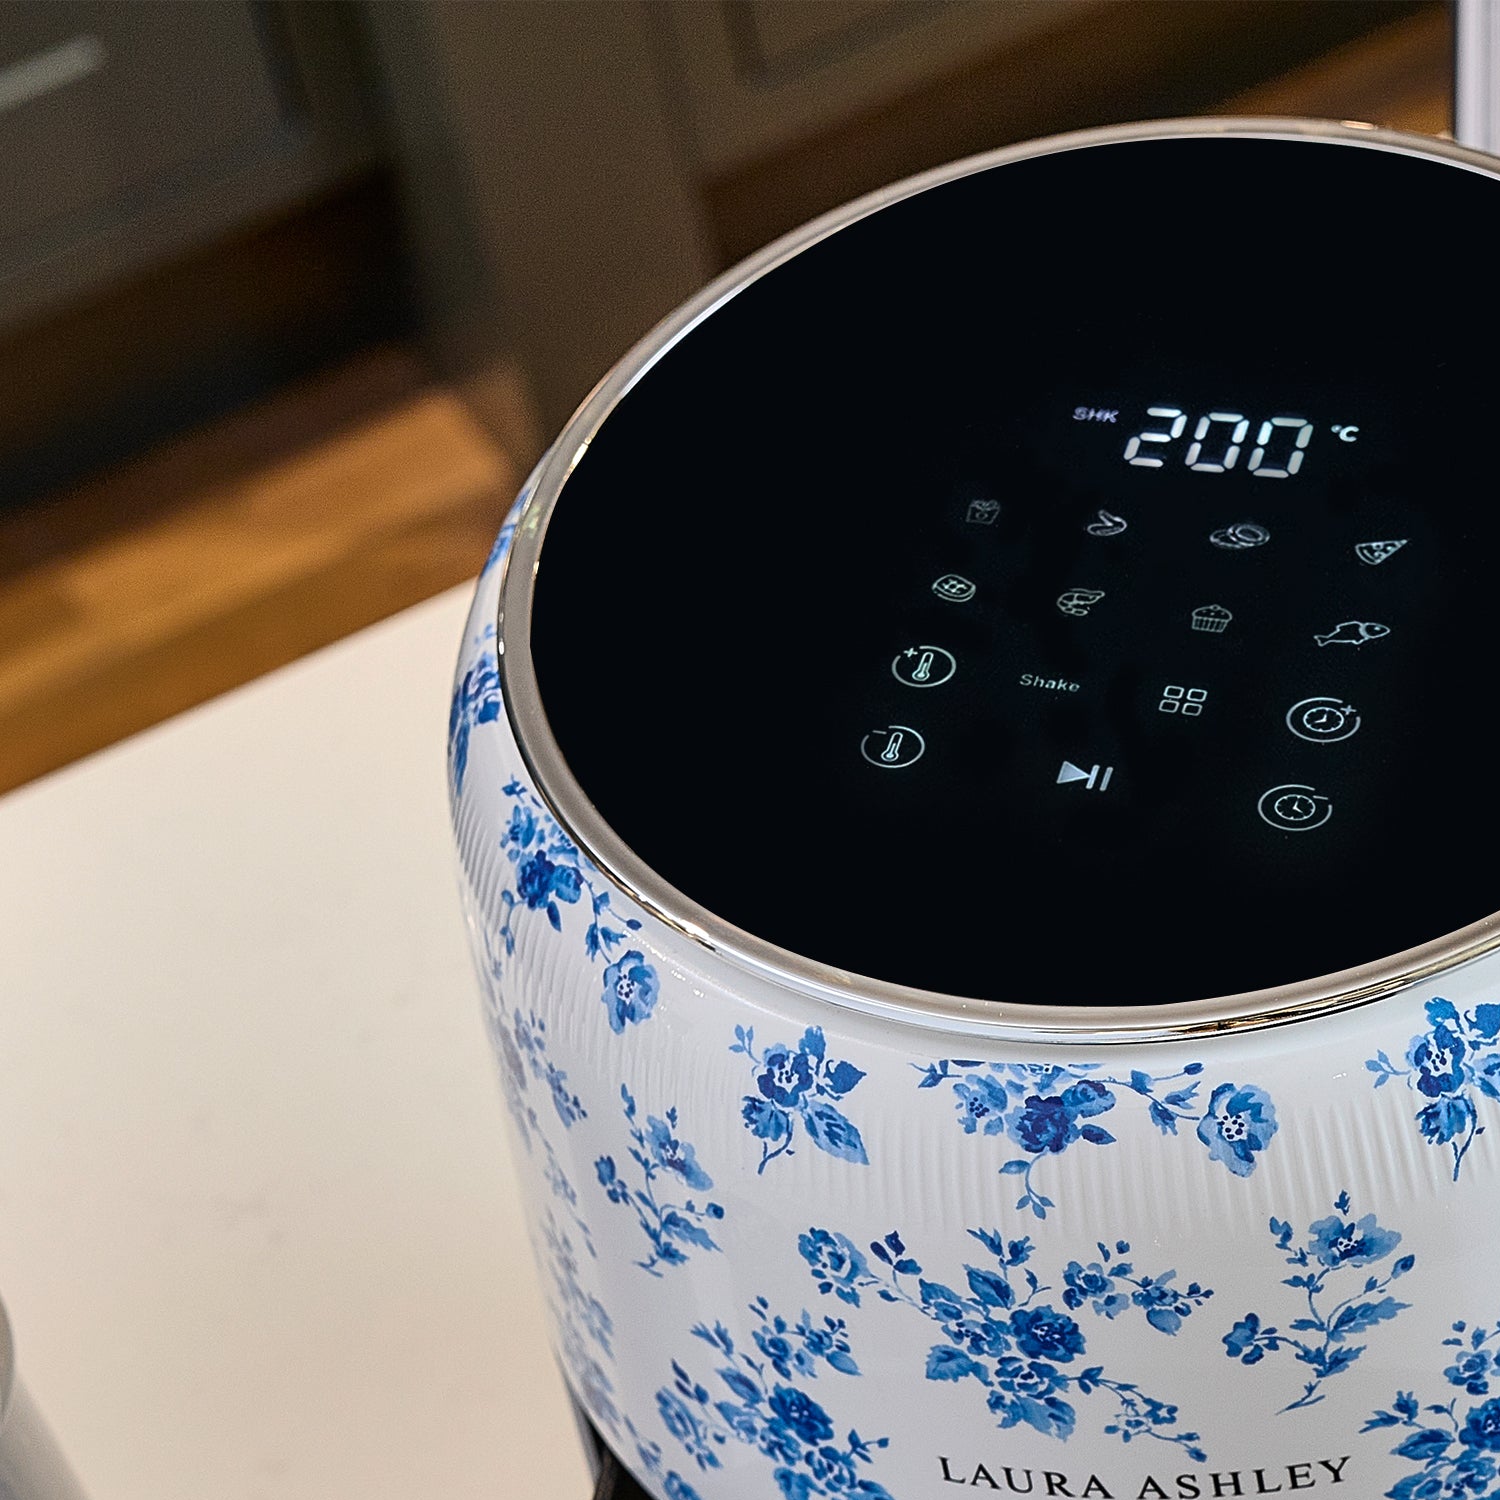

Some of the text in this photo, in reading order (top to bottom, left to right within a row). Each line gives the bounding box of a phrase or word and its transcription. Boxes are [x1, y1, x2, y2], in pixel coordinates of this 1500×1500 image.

[1123, 406, 1314, 479] 200
[1019, 673, 1081, 693] Shake
[937, 1455, 1352, 1500] LAURA ASHLEY
